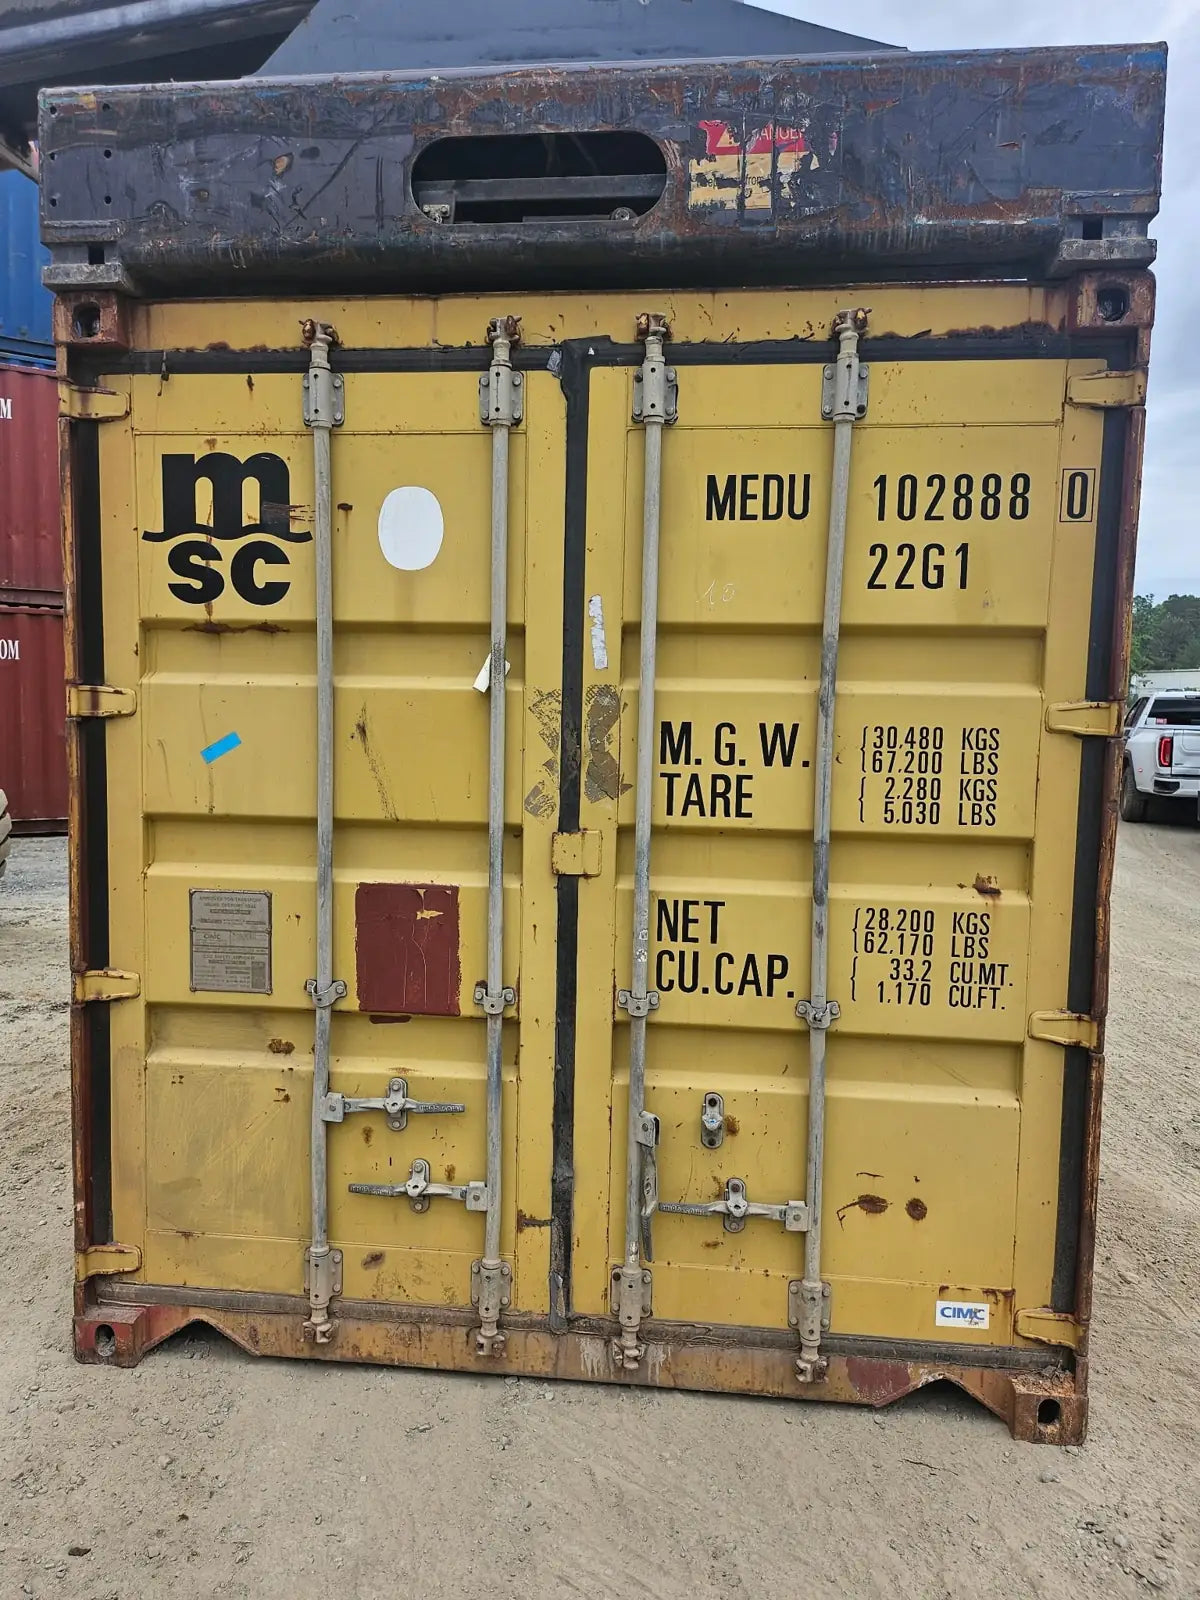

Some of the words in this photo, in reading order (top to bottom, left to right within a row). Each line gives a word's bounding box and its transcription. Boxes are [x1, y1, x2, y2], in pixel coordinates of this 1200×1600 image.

[706, 474, 810, 520] MEDU
[873, 473, 1031, 521] 102888
[1068, 471, 1089, 520] 0
[867, 542, 969, 589] 22G1
[873, 726, 944, 750] 30,480
[962, 727, 1000, 751] KGS
[872, 750, 942, 775] 67,200
[960, 751, 998, 775] LBS
[660, 773, 753, 818] TARE
[885, 776, 941, 801] 2,280
[959, 778, 998, 802] KGS
[883, 801, 940, 825] 5,030
[958, 803, 996, 826] LBS
[657, 899, 725, 944] NET
[865, 908, 935, 933] 28,200
[952, 912, 990, 936] KGS
[863, 932, 933, 956] 62,170
[951, 936, 988, 959] LBS
[655, 950, 795, 998] CU.CAP.
[889, 959, 932, 982] 33.2
[949, 962, 1014, 987] CU.MT.
[877, 981, 931, 1006] 1,170
[948, 986, 1006, 1010] CU.FT.
[940, 1306, 985, 1320] CIMC
